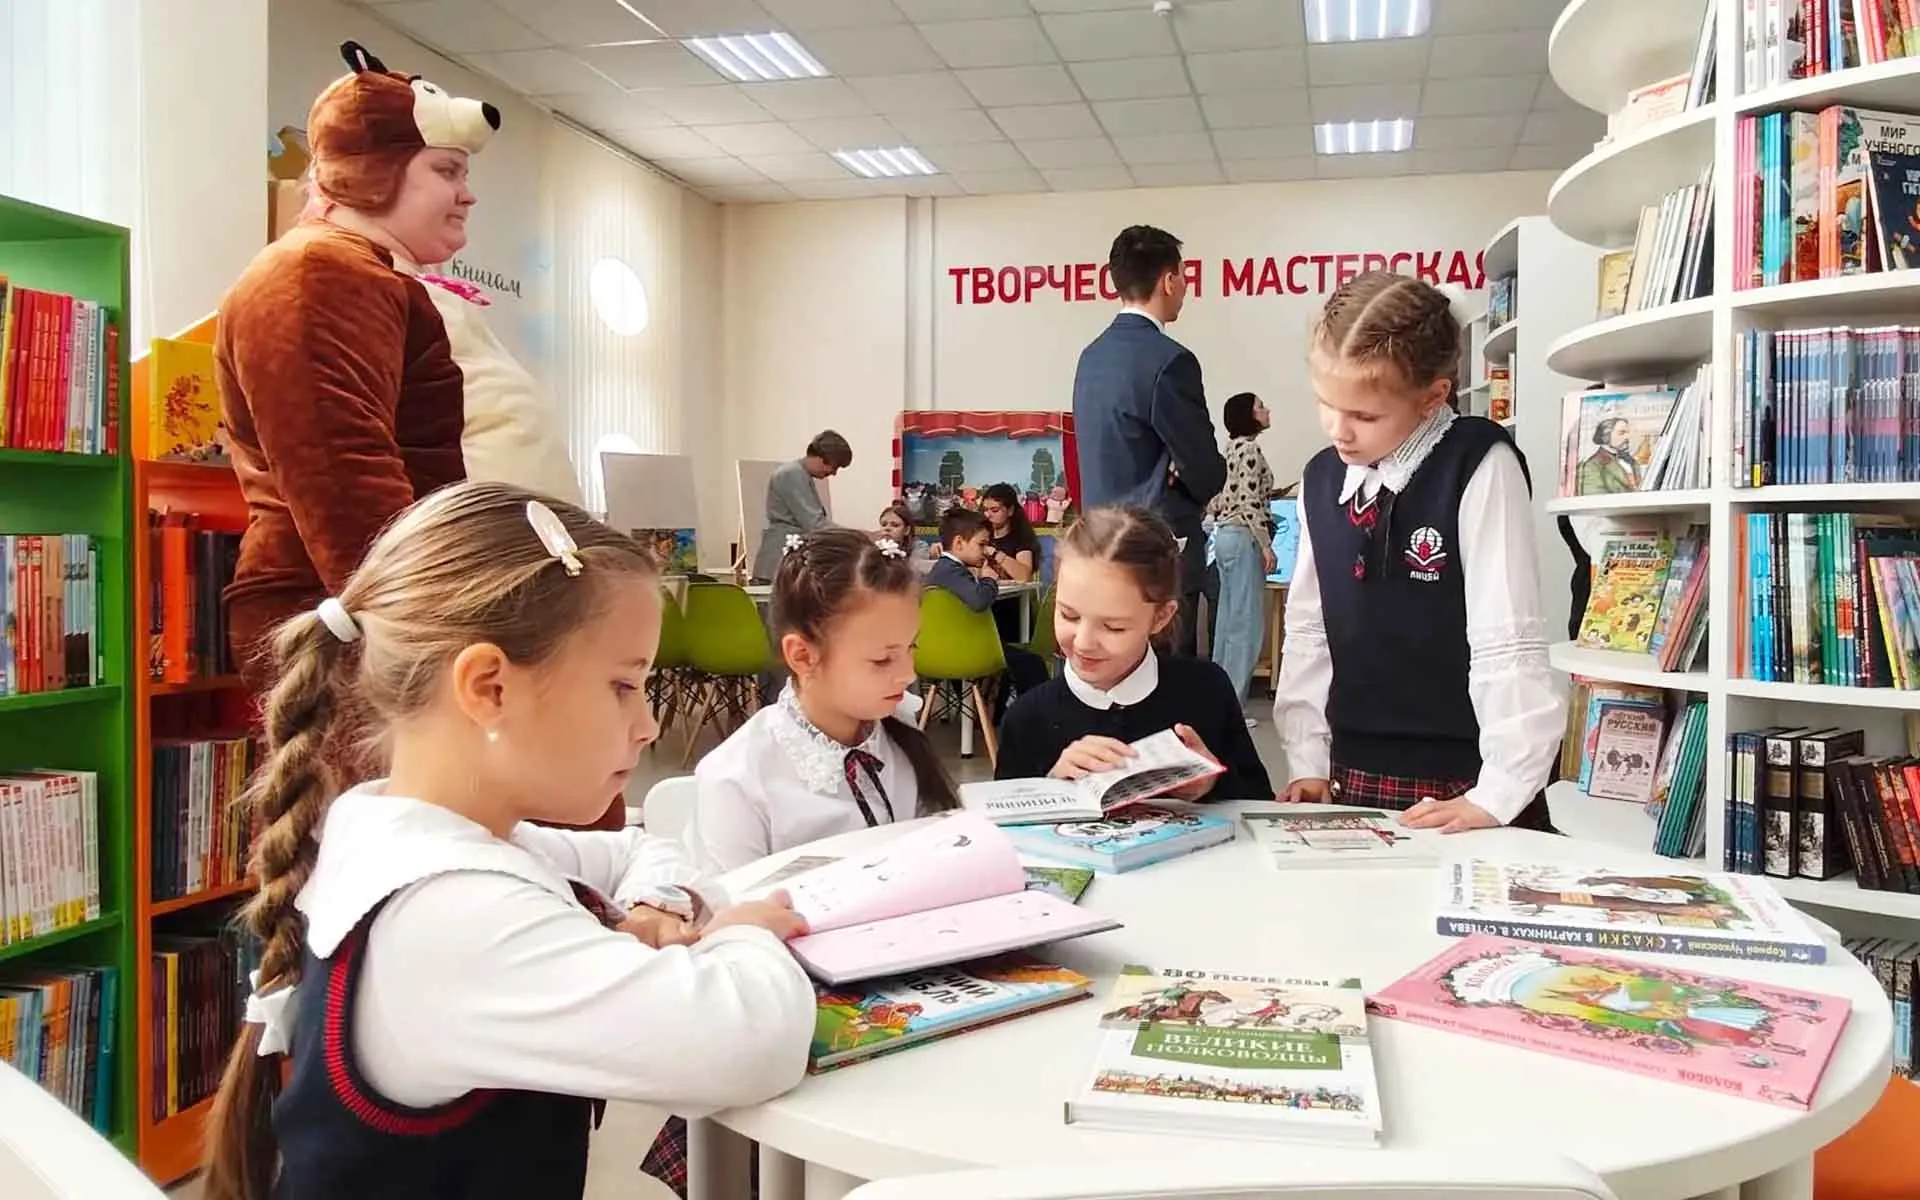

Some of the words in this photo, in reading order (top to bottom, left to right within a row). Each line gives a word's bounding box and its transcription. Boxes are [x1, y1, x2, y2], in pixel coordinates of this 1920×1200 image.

[1880, 126, 1906, 139] МИР
[948, 249, 1202, 304] ТВОРЧЕСЯ
[1606, 718, 1657, 732] РУССКИЙ
[1512, 927, 1583, 942] КАРТИНКАХ
[1598, 933, 1666, 949] СКАЗКИ
[1687, 940, 1744, 955] Чуковский
[1746, 945, 1787, 958] Корней
[942, 974, 999, 998] ЧИЙ
[1212, 974, 1329, 986] ПОБЕДЫ
[1163, 1033, 1314, 1053] ВЕЛИКИЕ
[1146, 1043, 1328, 1064] ПОЛКОВОДЦЫ
[1677, 1068, 1743, 1092] КОЛОБОК
